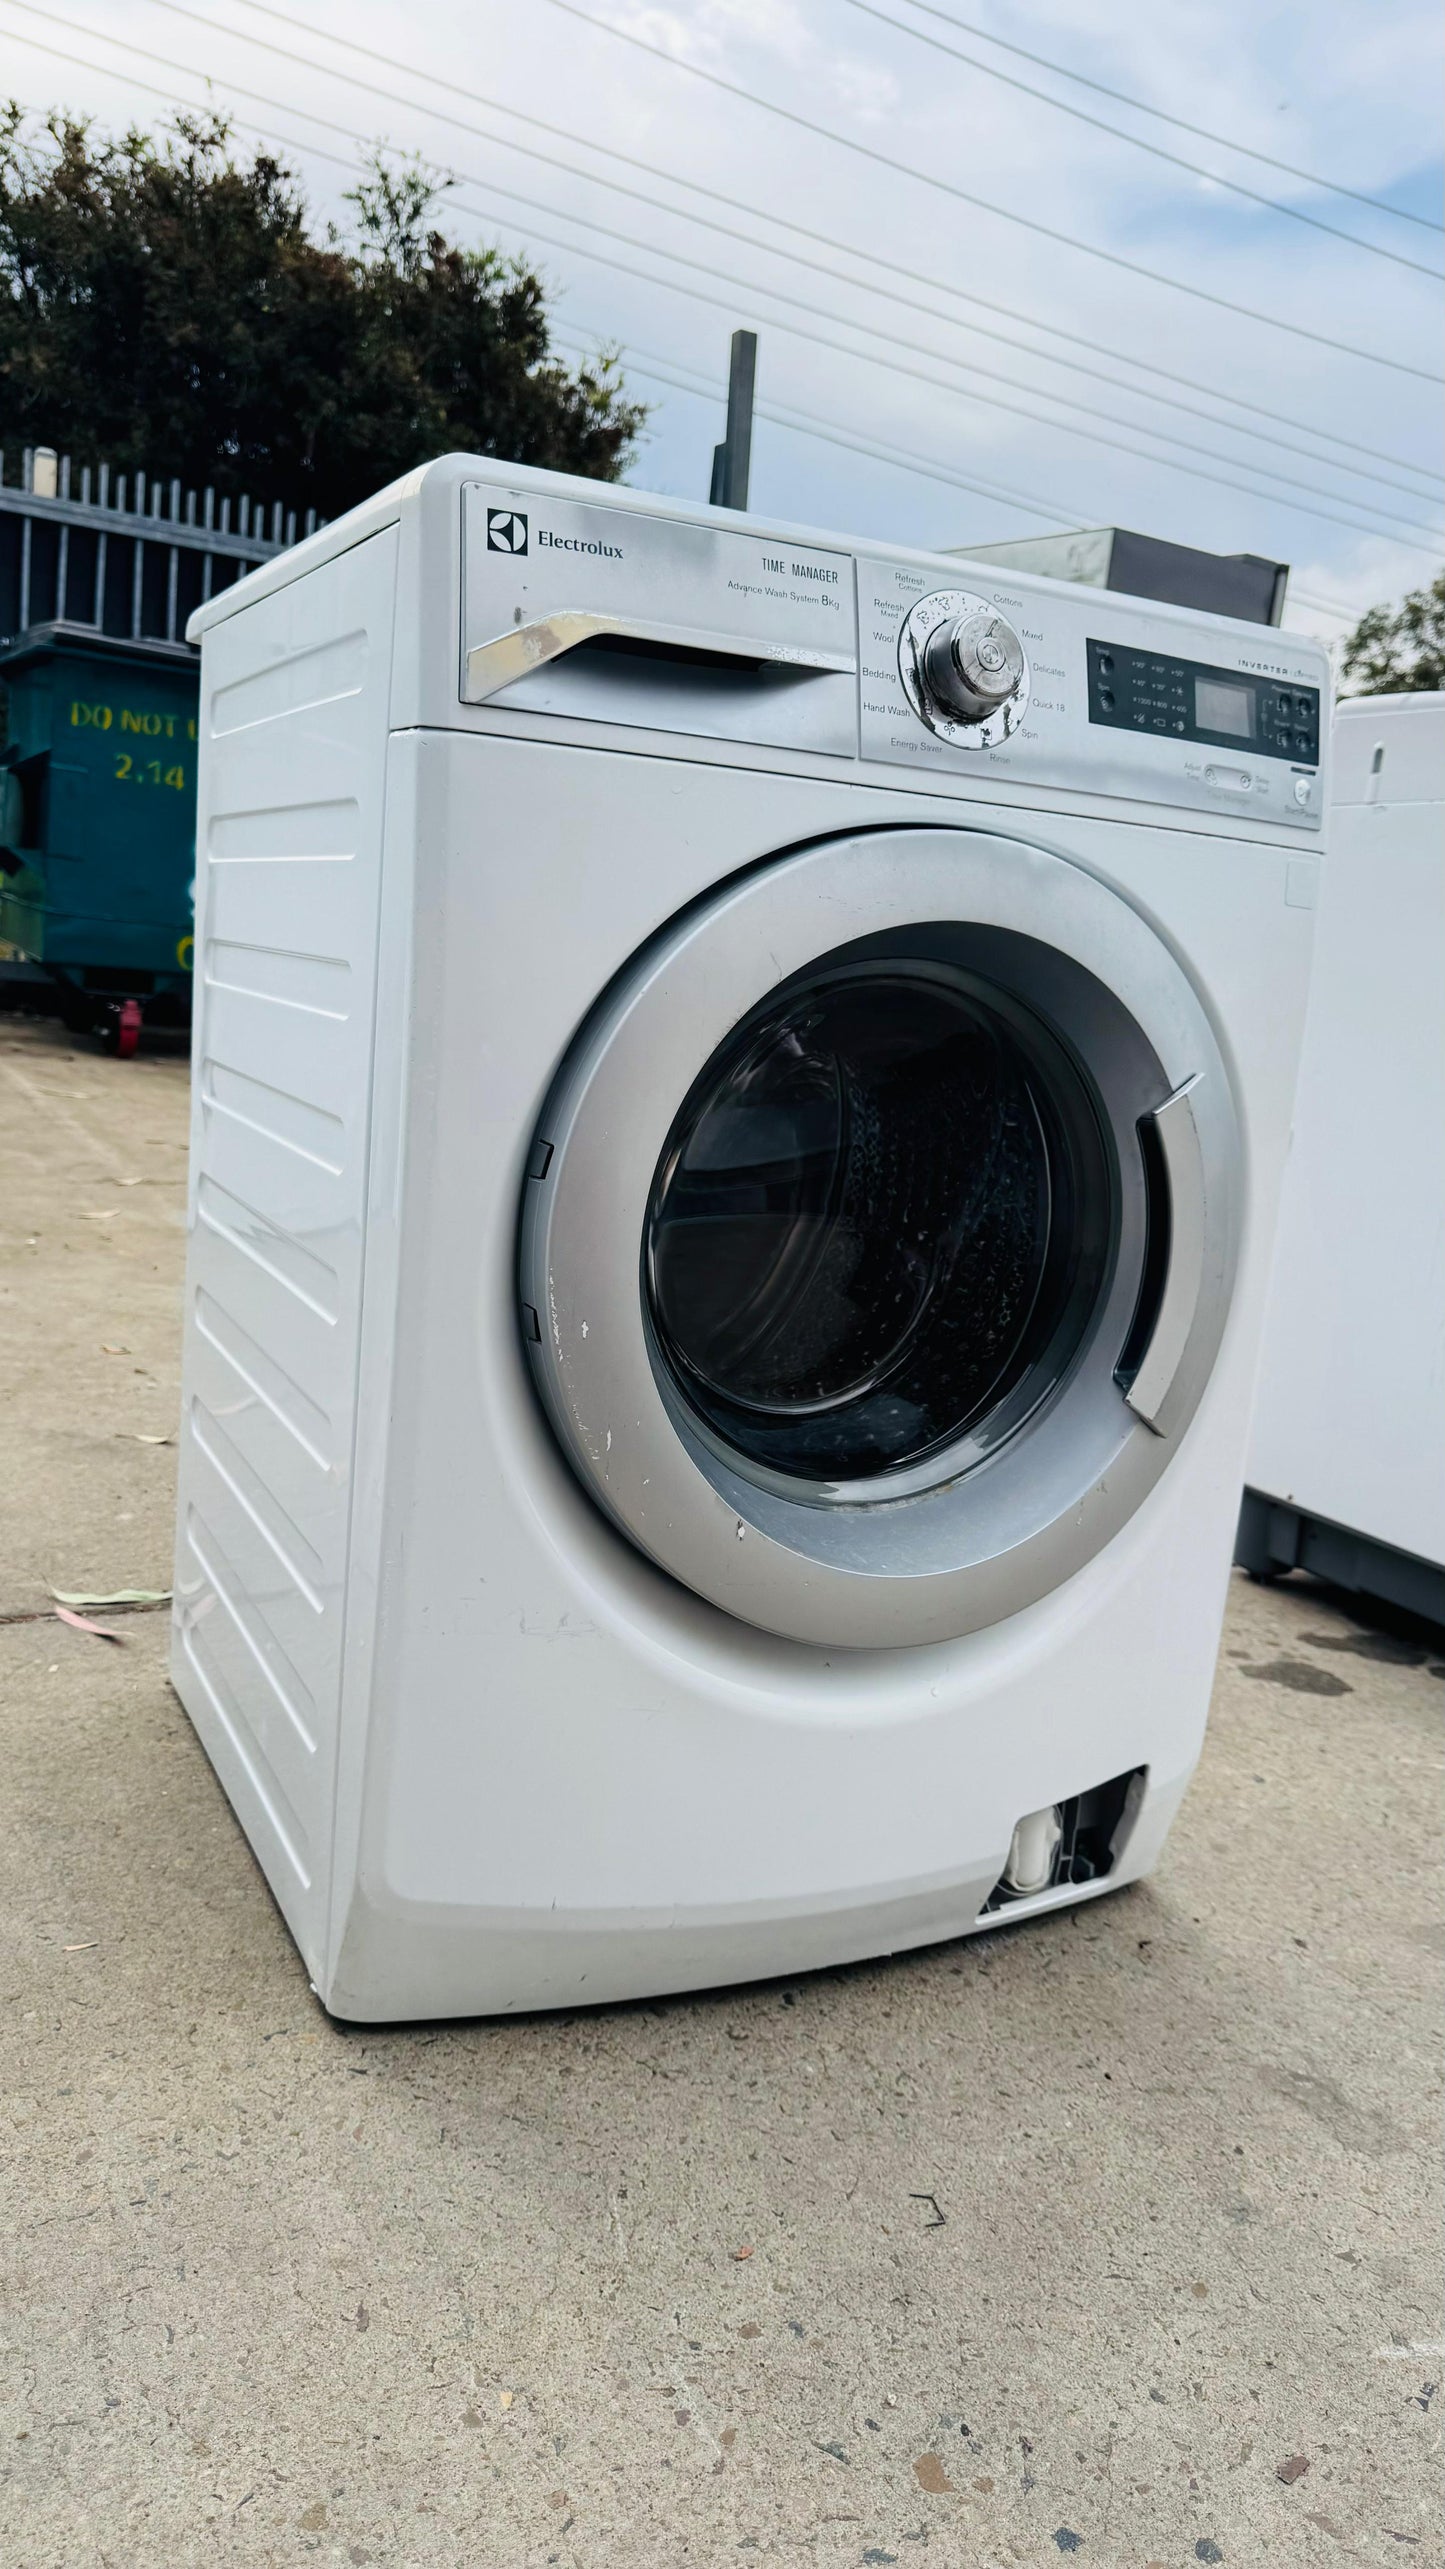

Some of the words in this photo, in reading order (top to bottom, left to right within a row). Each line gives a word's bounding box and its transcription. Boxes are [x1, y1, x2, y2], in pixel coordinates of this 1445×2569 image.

[537, 530, 624, 560] Electrolux
[762, 557, 786, 574] TIME
[792, 563, 839, 584] MANAGER
[894, 572, 926, 586] Refresh
[727, 580, 763, 595] Advance
[764, 586, 788, 599] Wash
[789, 591, 820, 605] System
[993, 593, 1023, 608] Cottons
[873, 598, 905, 613] Refresh
[872, 631, 895, 643] Wool
[1021, 629, 1044, 641] Mixed
[862, 666, 897, 684] Bedding
[1032, 662, 1066, 678] Delicates
[1237, 659, 1289, 675] INVERTER
[863, 701, 887, 714] Hand
[887, 705, 911, 718] Wash
[1032, 697, 1054, 710] Quick
[70, 701, 113, 731] DO
[120, 708, 179, 739] NOT
[1021, 728, 1040, 740] Spin
[890, 737, 919, 752] Energy
[919, 741, 944, 754] Saver
[989, 753, 1011, 765] Rinse
[114, 753, 185, 791] 2.14
